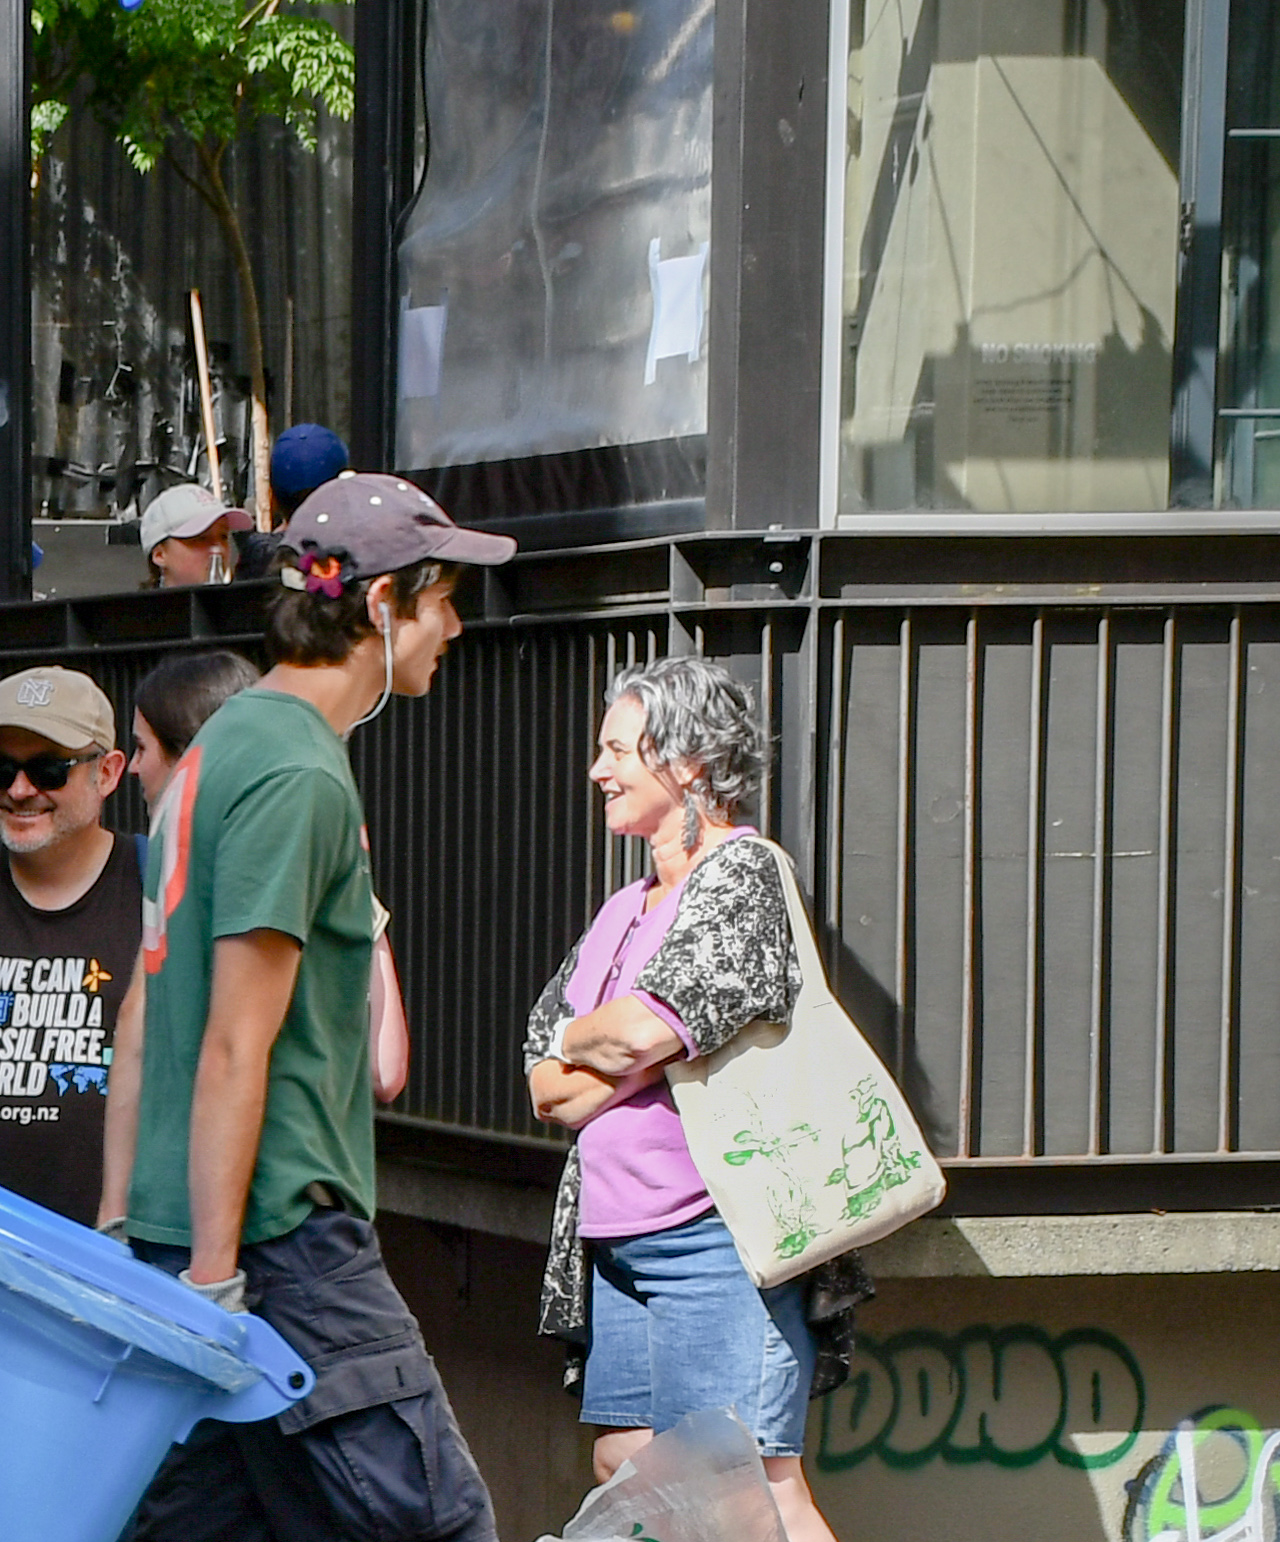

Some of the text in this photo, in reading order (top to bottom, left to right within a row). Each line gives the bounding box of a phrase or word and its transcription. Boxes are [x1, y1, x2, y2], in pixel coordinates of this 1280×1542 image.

[30, 956, 85, 992] CAN
[11, 992, 102, 1028] BUILD A
[41, 1028, 105, 1065] FREE
